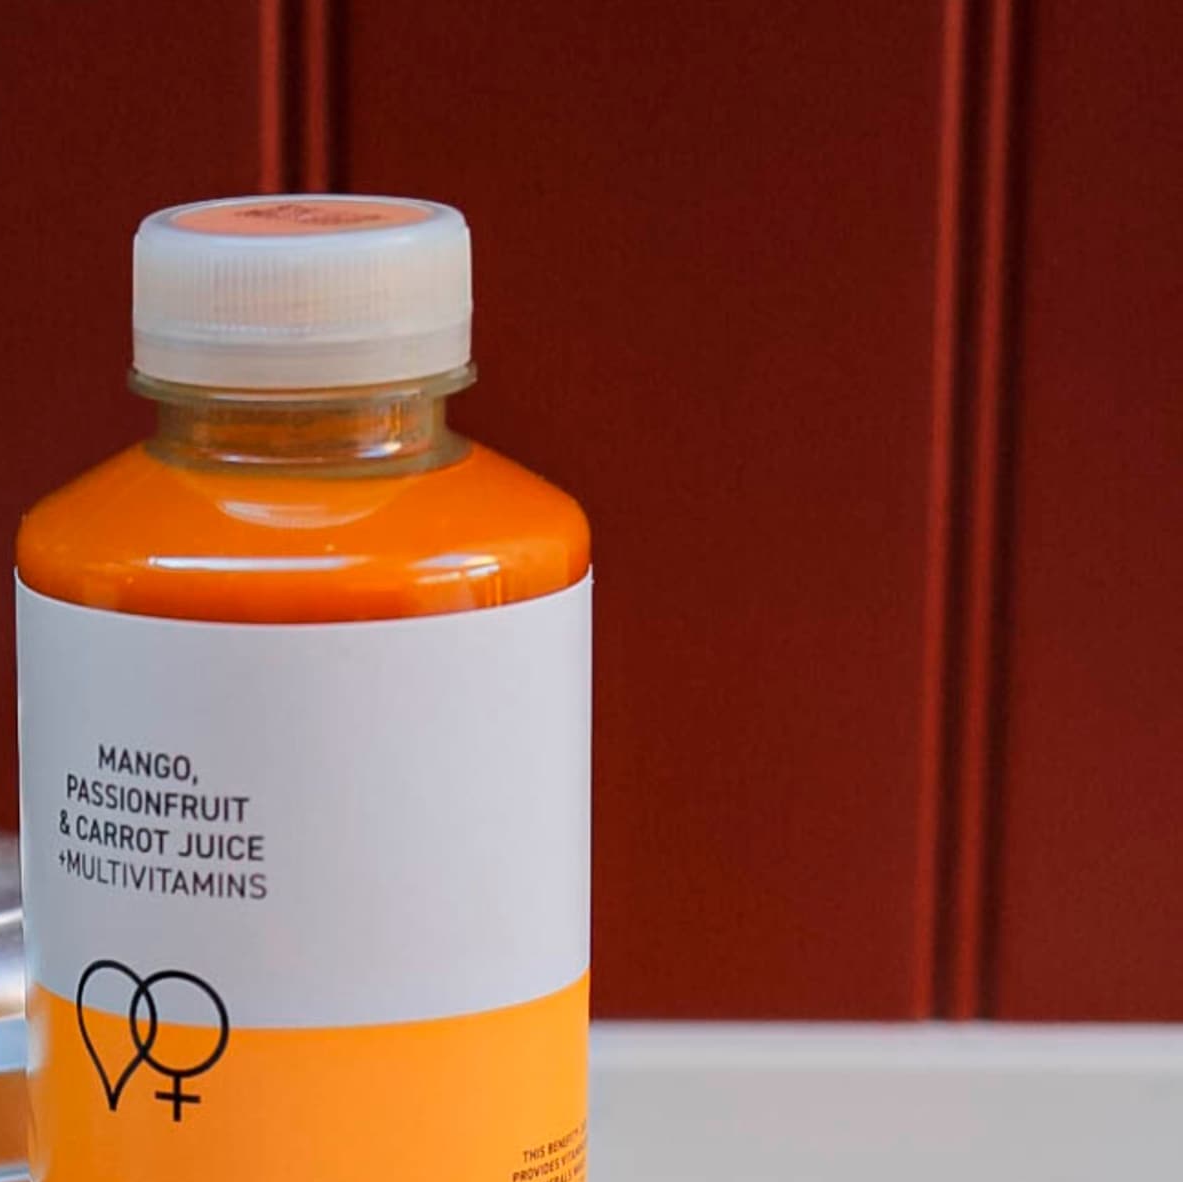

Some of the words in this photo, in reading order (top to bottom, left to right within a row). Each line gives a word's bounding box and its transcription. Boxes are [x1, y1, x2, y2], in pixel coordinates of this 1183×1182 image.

[98, 744, 199, 785] MANGO,
[66, 774, 250, 823] PASSIONFRUIT
[59, 809, 70, 835] &
[75, 815, 170, 855] CARROT
[178, 832, 265, 861] JUICE
[58, 849, 267, 900] +MULTIVITAMINS
